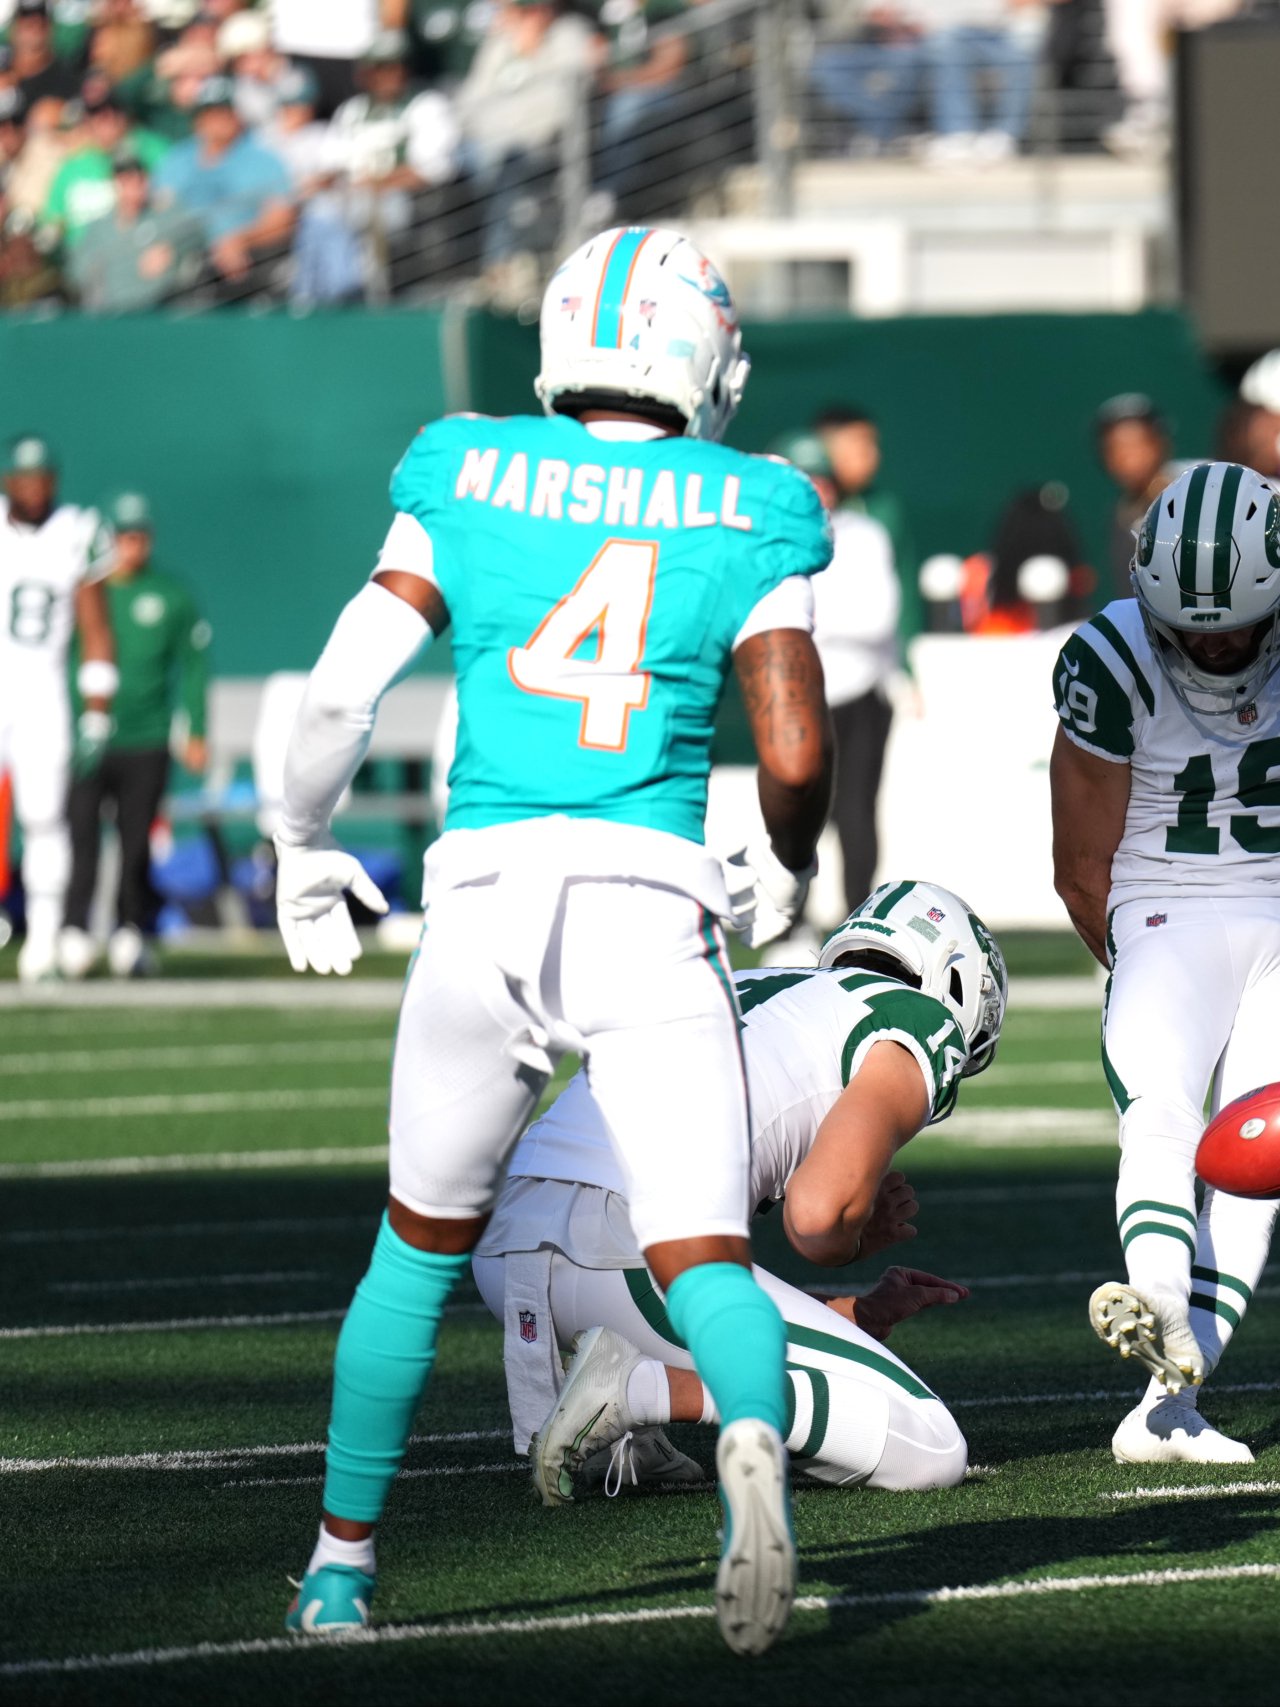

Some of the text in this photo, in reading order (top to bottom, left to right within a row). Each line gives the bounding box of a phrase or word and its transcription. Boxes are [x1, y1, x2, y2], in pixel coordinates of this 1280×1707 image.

[455, 448, 752, 531] MARSHALL
[9, 578, 54, 647] 8
[507, 537, 660, 753] 4
[1058, 671, 1098, 733] 19
[521, 1322, 537, 1339] NFL
